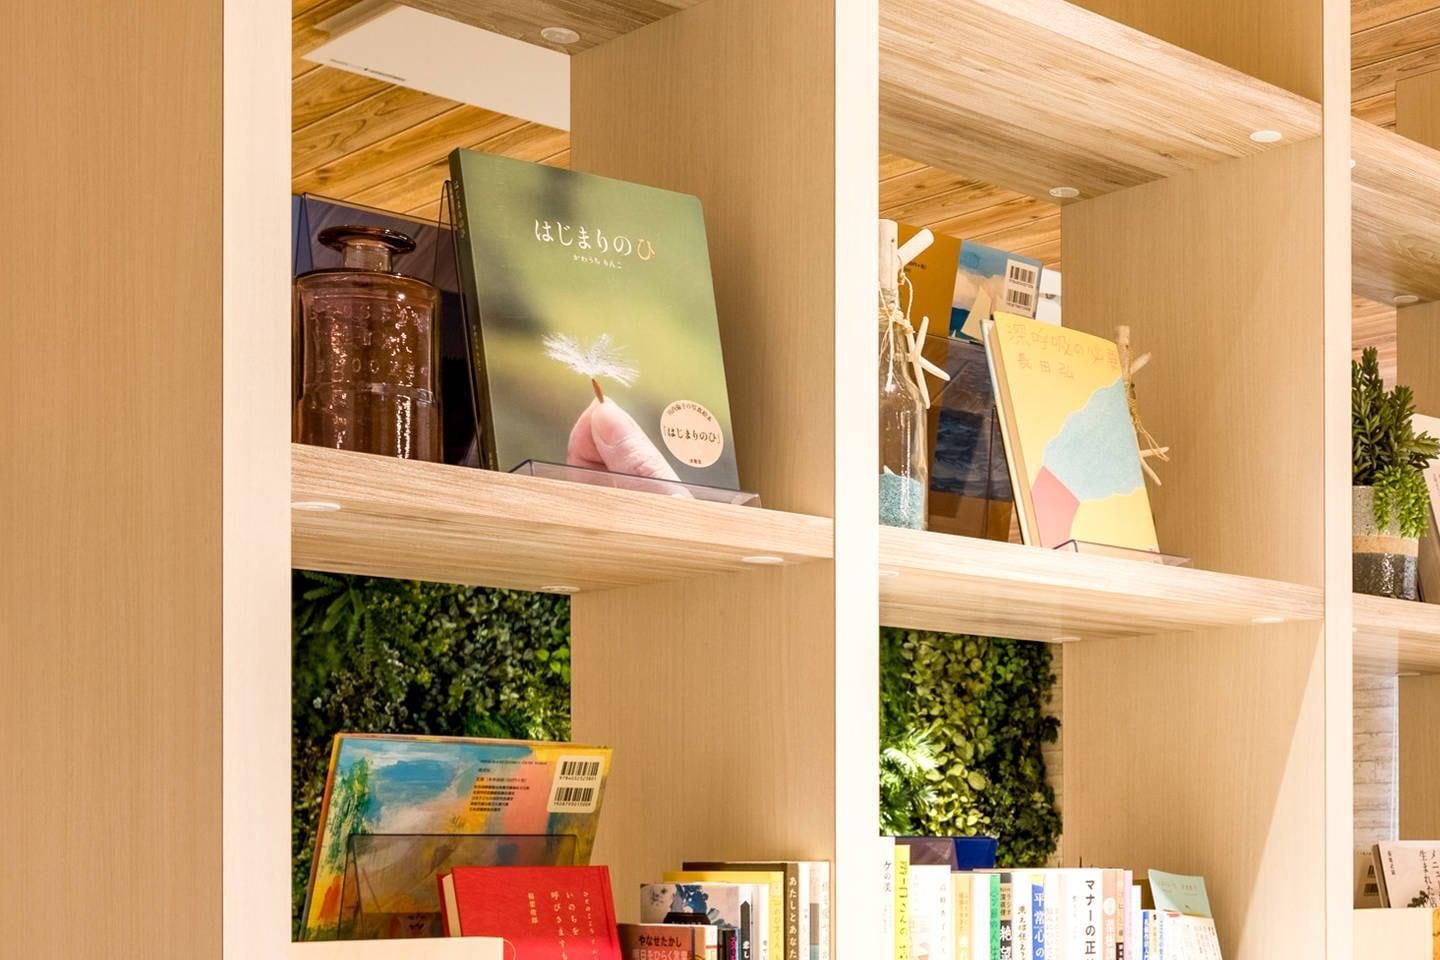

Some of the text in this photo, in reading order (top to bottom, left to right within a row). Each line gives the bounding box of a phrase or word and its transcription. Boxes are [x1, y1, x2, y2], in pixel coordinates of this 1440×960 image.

[535, 219, 656, 261] はじまりのひ
[788, 876, 798, 959] あたしとあなた
[639, 934, 682, 948] やなせたかし
